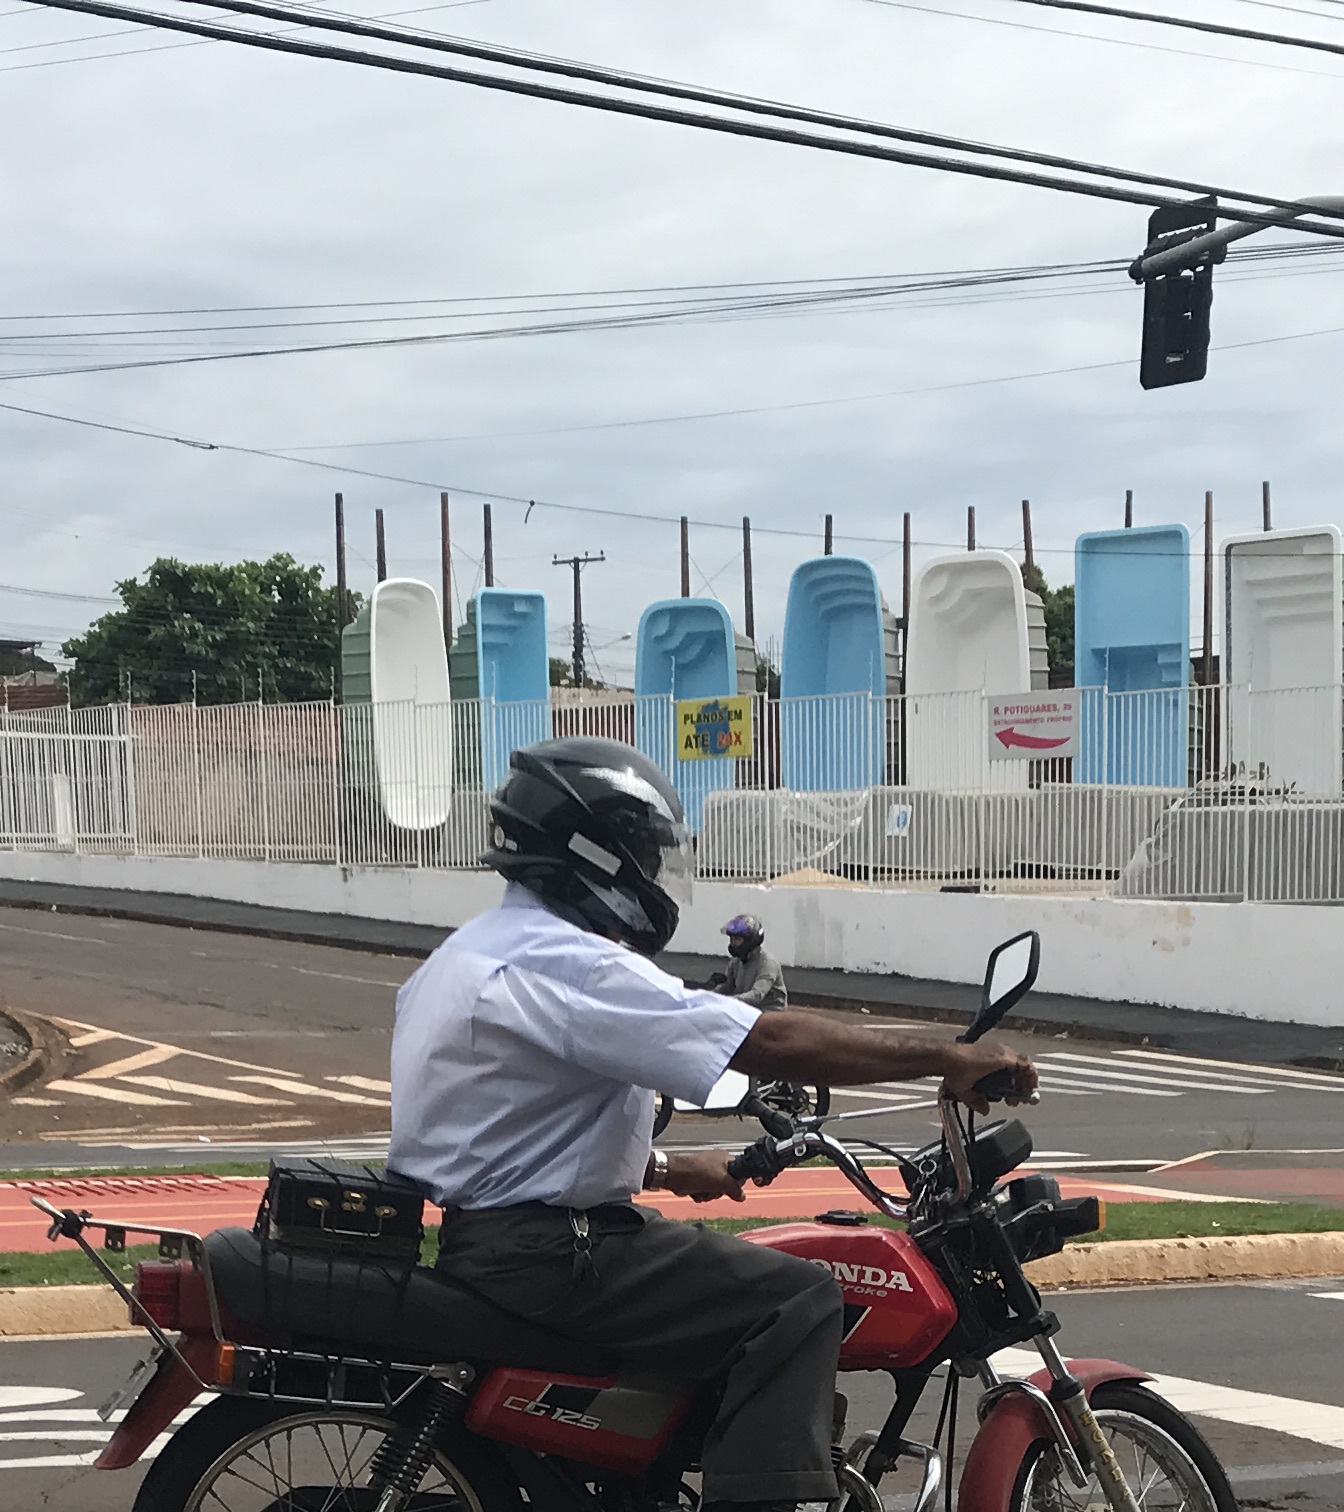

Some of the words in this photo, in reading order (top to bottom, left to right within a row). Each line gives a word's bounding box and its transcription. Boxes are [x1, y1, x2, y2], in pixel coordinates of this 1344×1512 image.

[684, 712, 724, 725] PLANOS
[727, 709, 742, 721] EM
[503, 1396, 551, 1417] CG
[551, 1407, 602, 1430] 125
